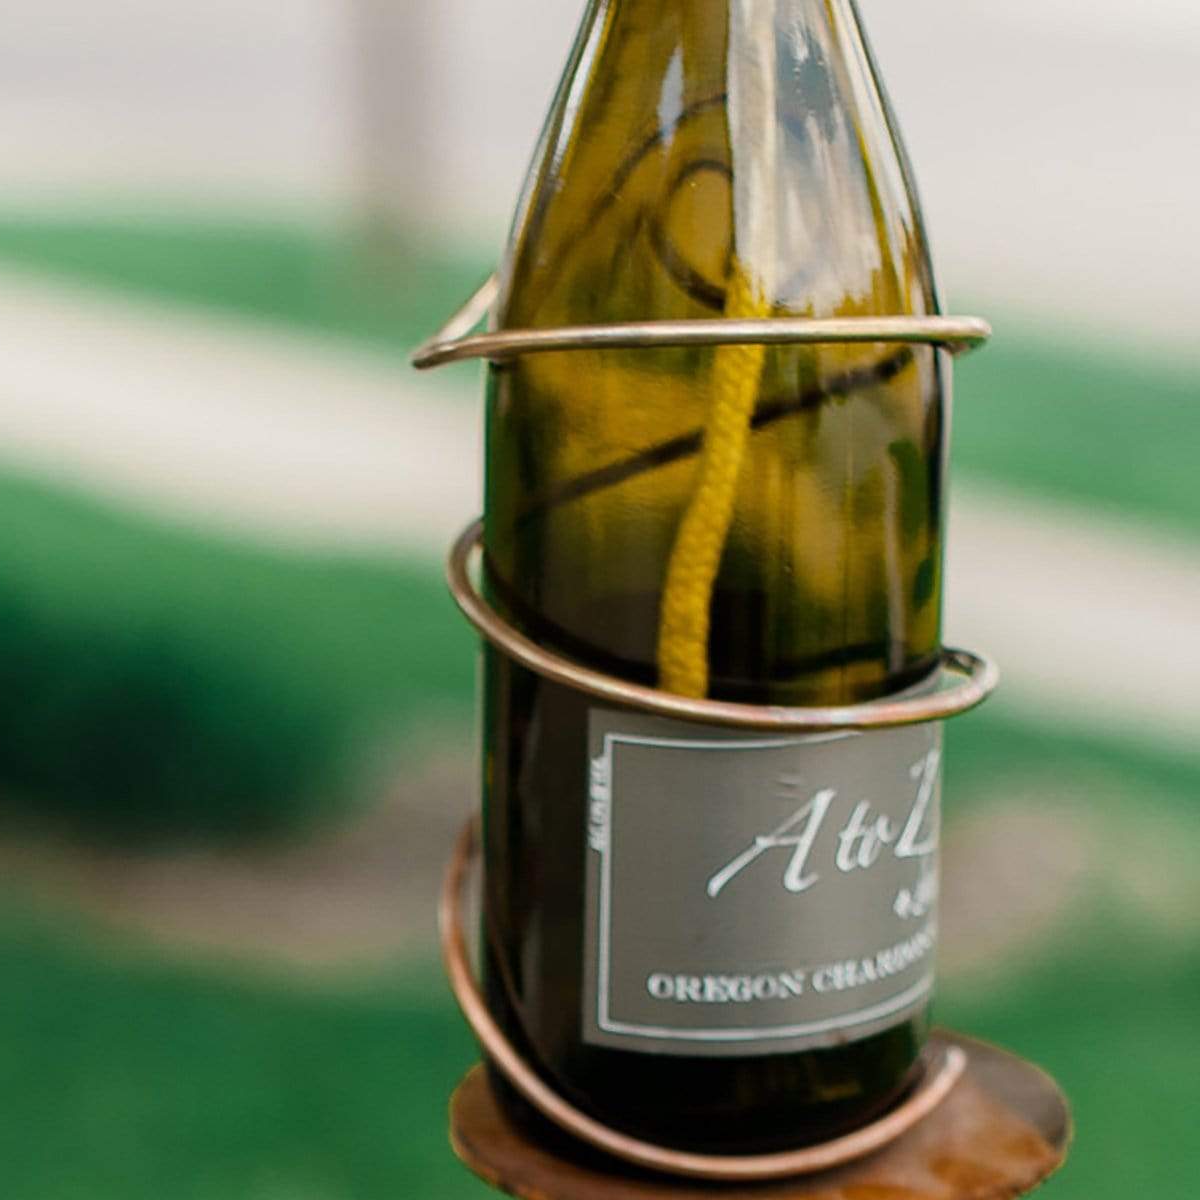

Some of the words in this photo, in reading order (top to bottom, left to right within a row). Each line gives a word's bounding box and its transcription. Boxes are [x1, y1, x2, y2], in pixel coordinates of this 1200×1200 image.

[707, 788, 836, 898] A
[836, 800, 895, 872] to
[647, 971, 806, 1003] OREGON
